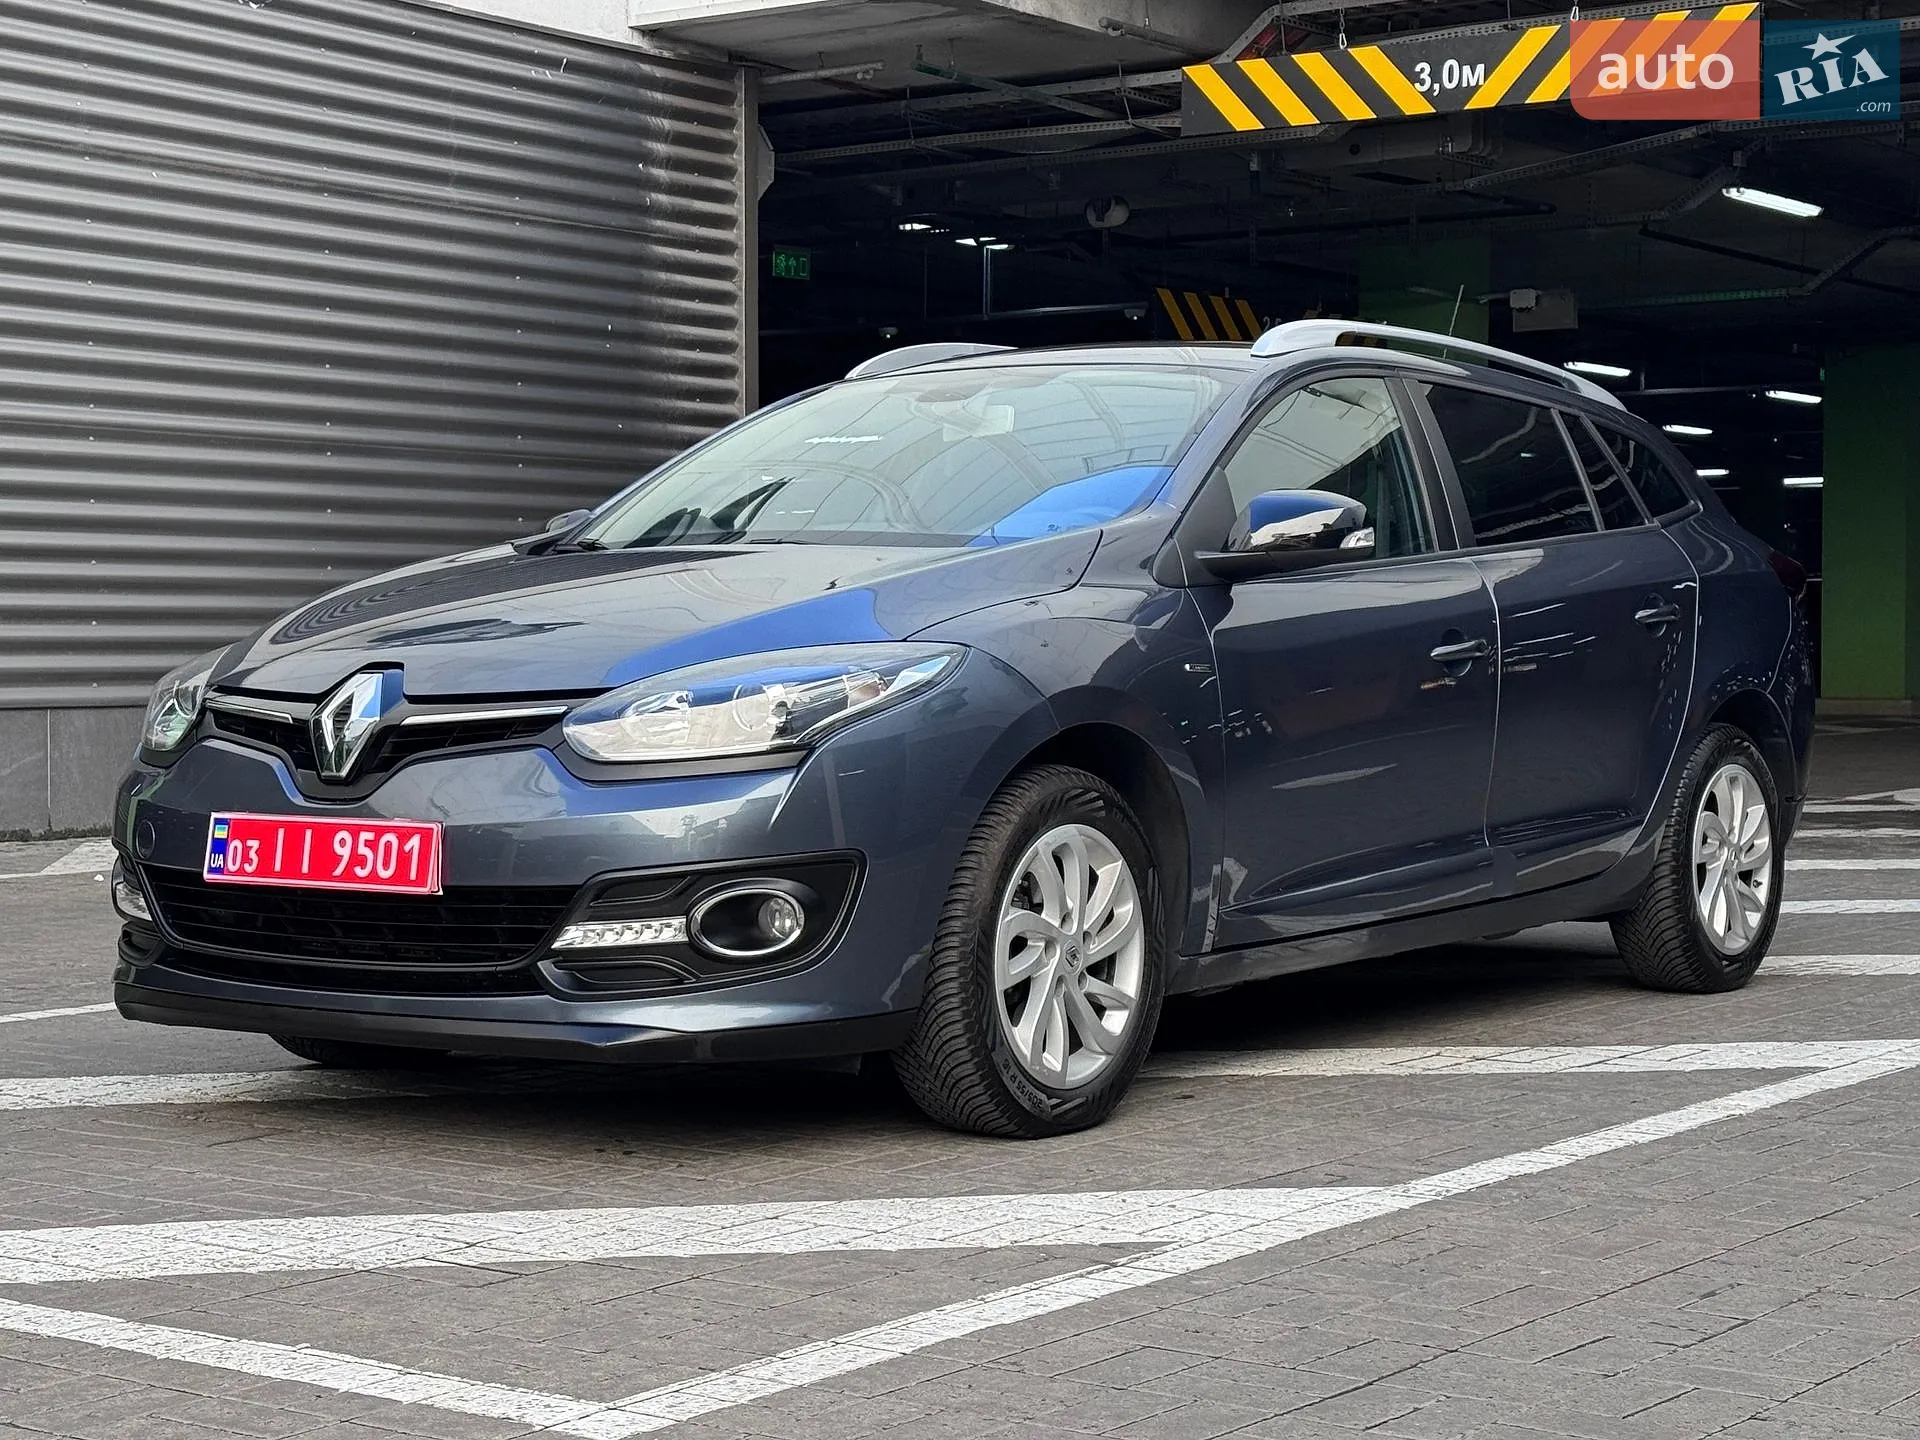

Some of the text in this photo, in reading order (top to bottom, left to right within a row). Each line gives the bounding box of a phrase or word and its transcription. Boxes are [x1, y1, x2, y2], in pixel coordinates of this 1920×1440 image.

[210, 853, 224, 869] UA
[227, 839, 260, 874] 03
[331, 829, 422, 881] 9501
